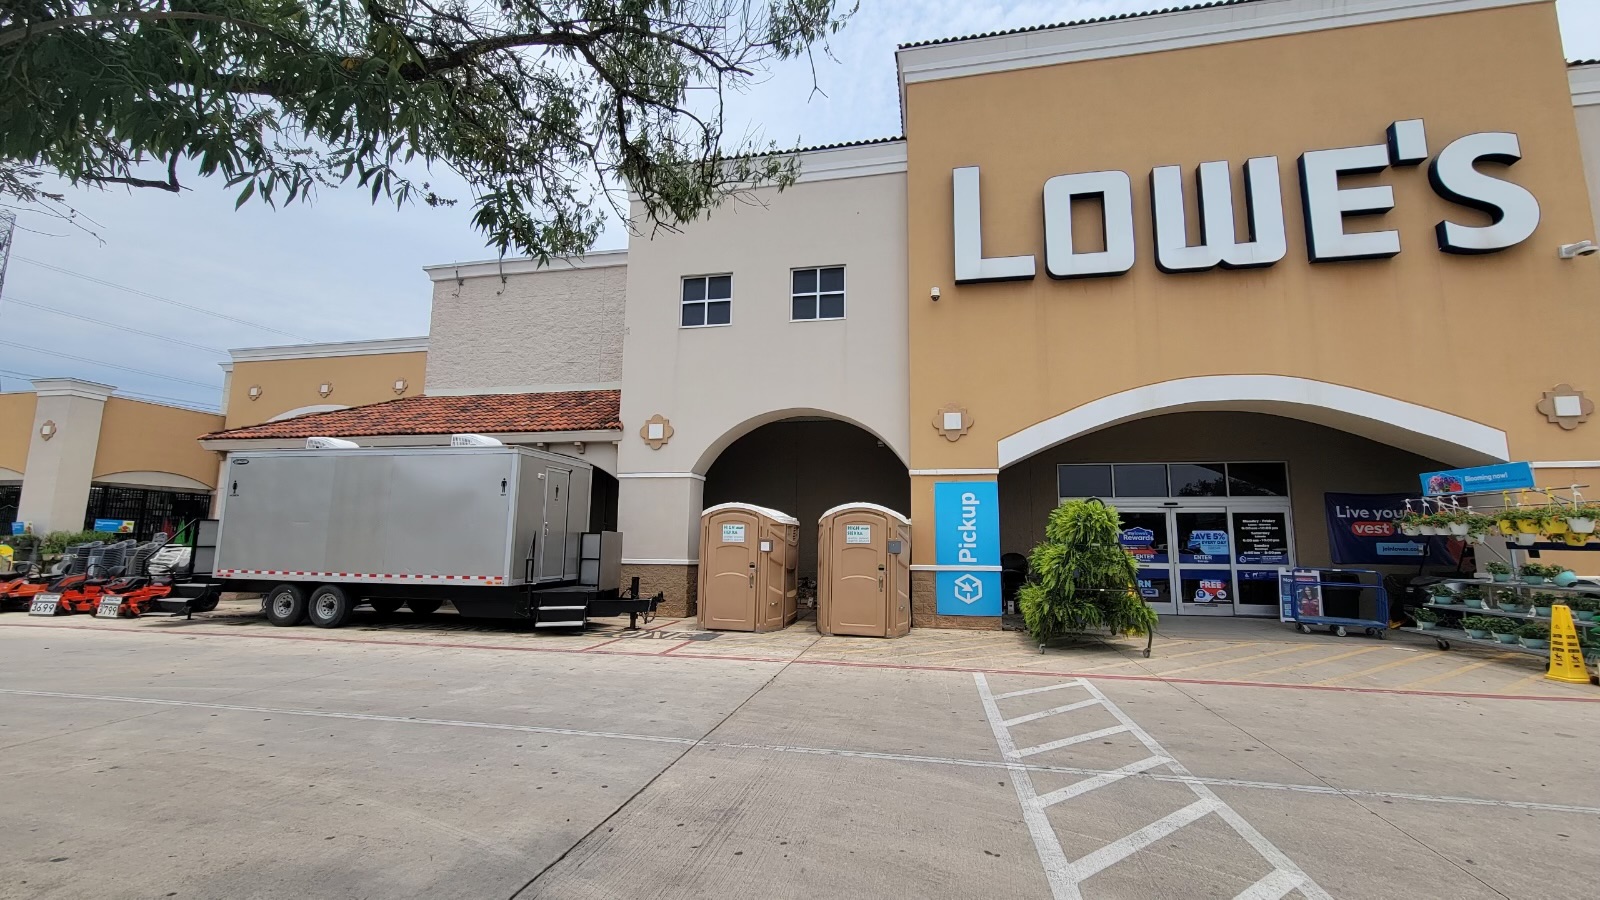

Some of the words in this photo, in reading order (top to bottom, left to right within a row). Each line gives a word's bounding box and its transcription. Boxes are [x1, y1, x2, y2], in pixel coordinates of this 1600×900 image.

[952, 118, 1541, 284] LOWE'S
[1464, 473, 1492, 482] Blooming
[1493, 471, 1508, 479] now!
[1335, 505, 1370, 518] Live
[958, 492, 980, 563] Pickup
[1354, 523, 1390, 534] vest
[1213, 532, 1226, 541] 5%
[1200, 580, 1222, 589] FREE
[31, 603, 54, 612] 3699
